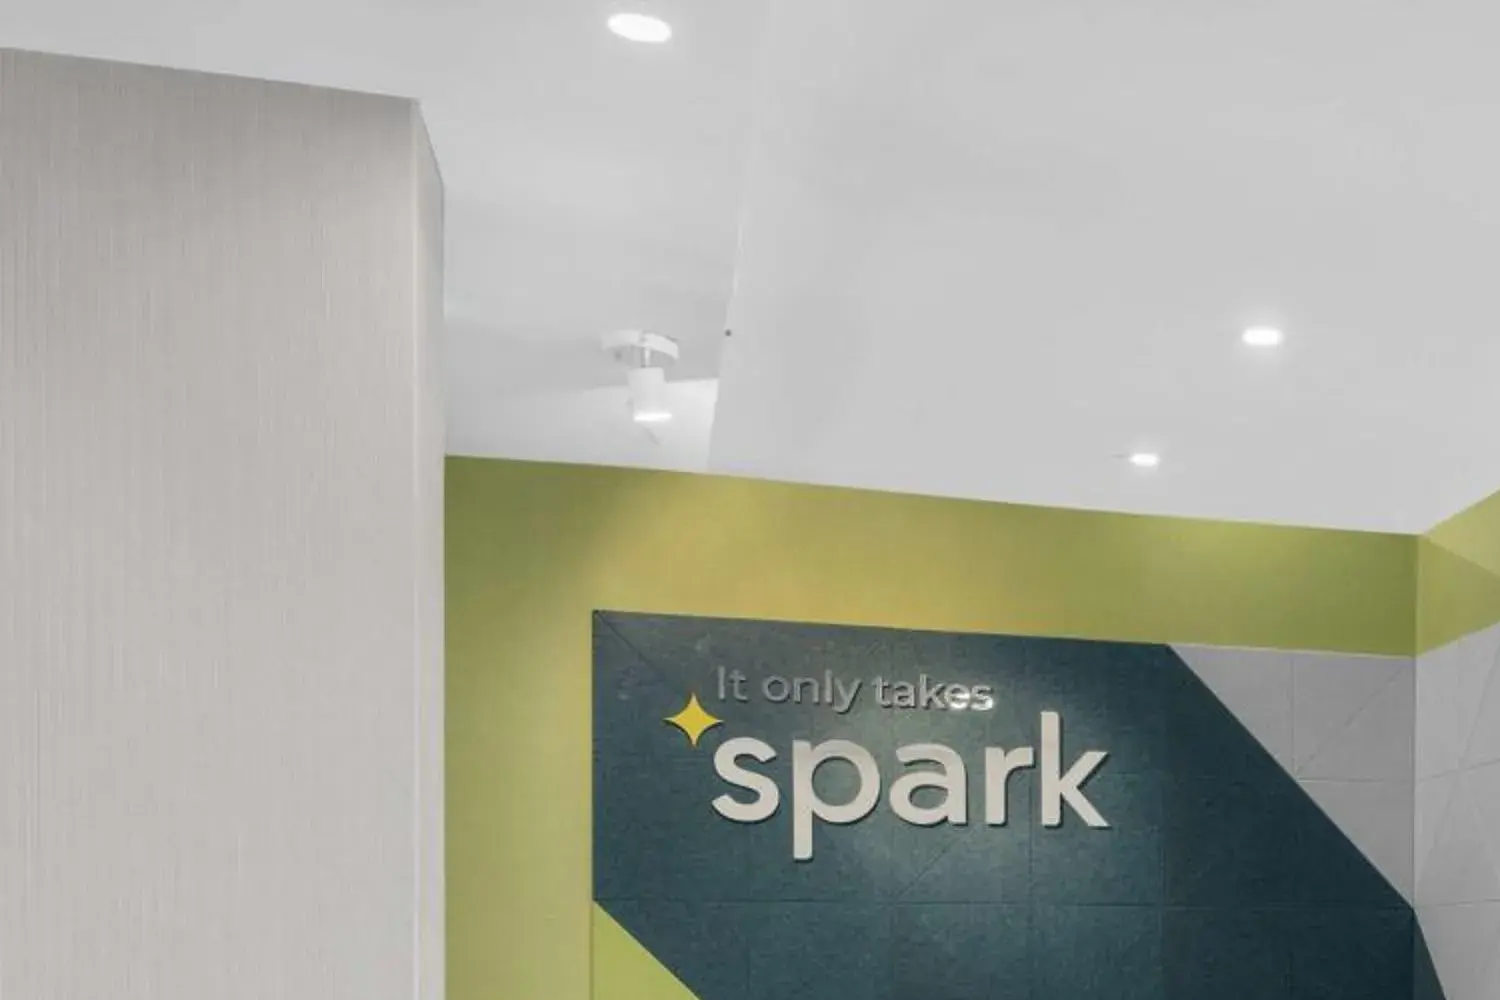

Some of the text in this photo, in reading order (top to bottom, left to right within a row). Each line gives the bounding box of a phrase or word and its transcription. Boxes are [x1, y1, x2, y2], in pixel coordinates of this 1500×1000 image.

[716, 665, 995, 714] It only takes
[711, 711, 1111, 860] spark
